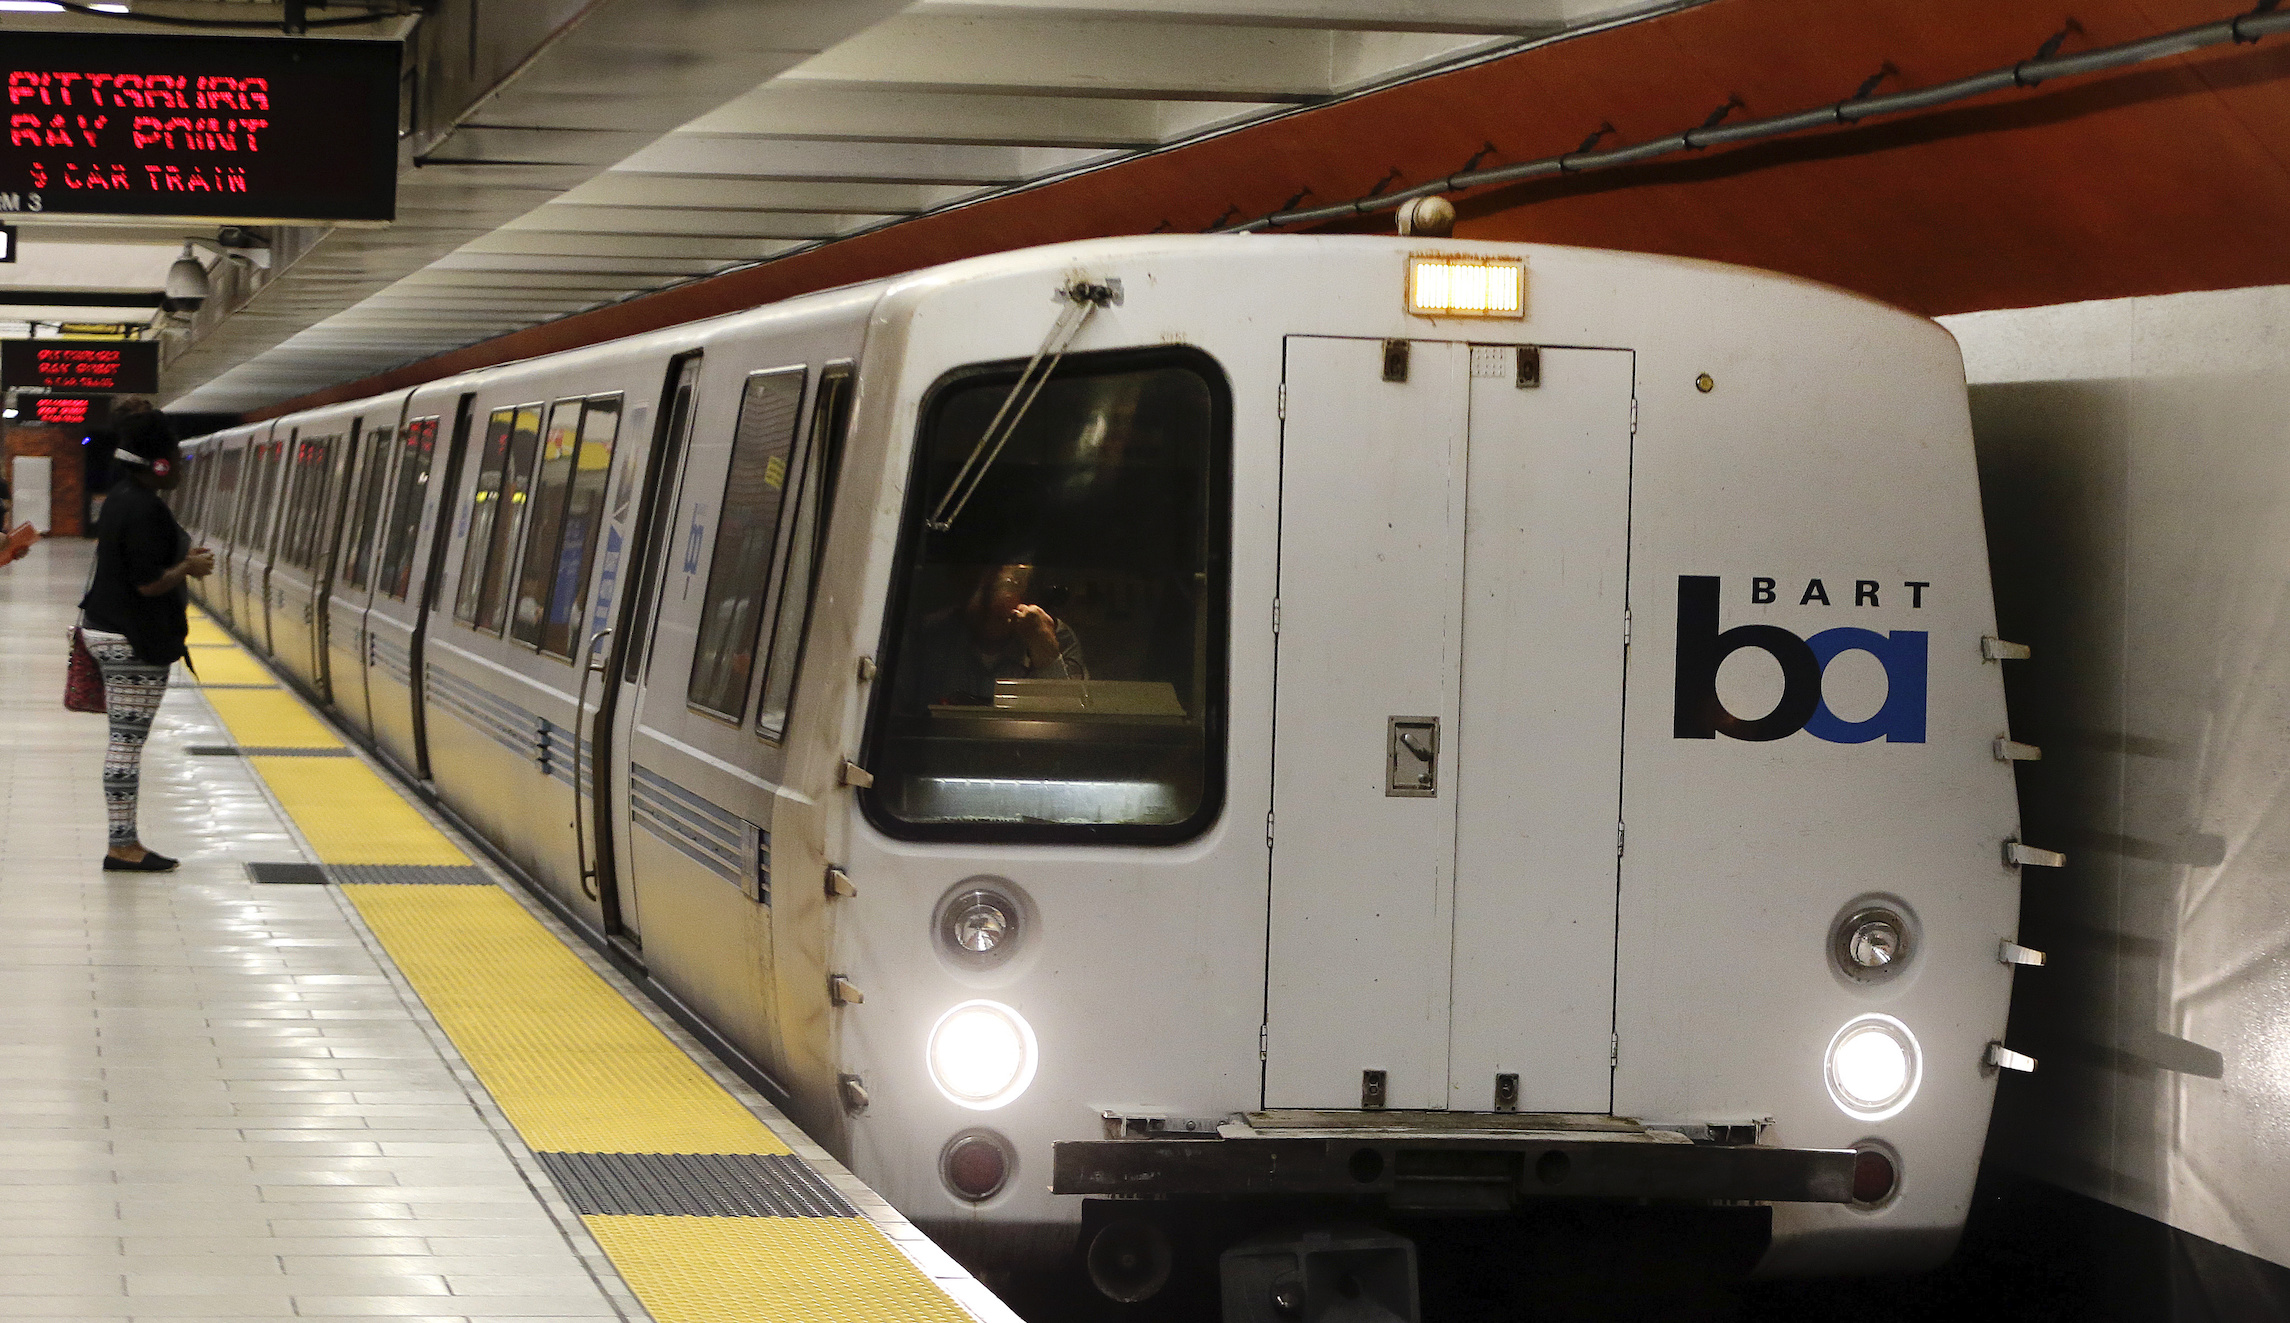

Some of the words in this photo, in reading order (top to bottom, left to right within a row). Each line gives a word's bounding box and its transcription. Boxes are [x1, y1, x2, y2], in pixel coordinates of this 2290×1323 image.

[63, 162, 130, 190] CAR
[144, 164, 247, 193] TRAIN
[1751, 577, 1930, 608] BART
